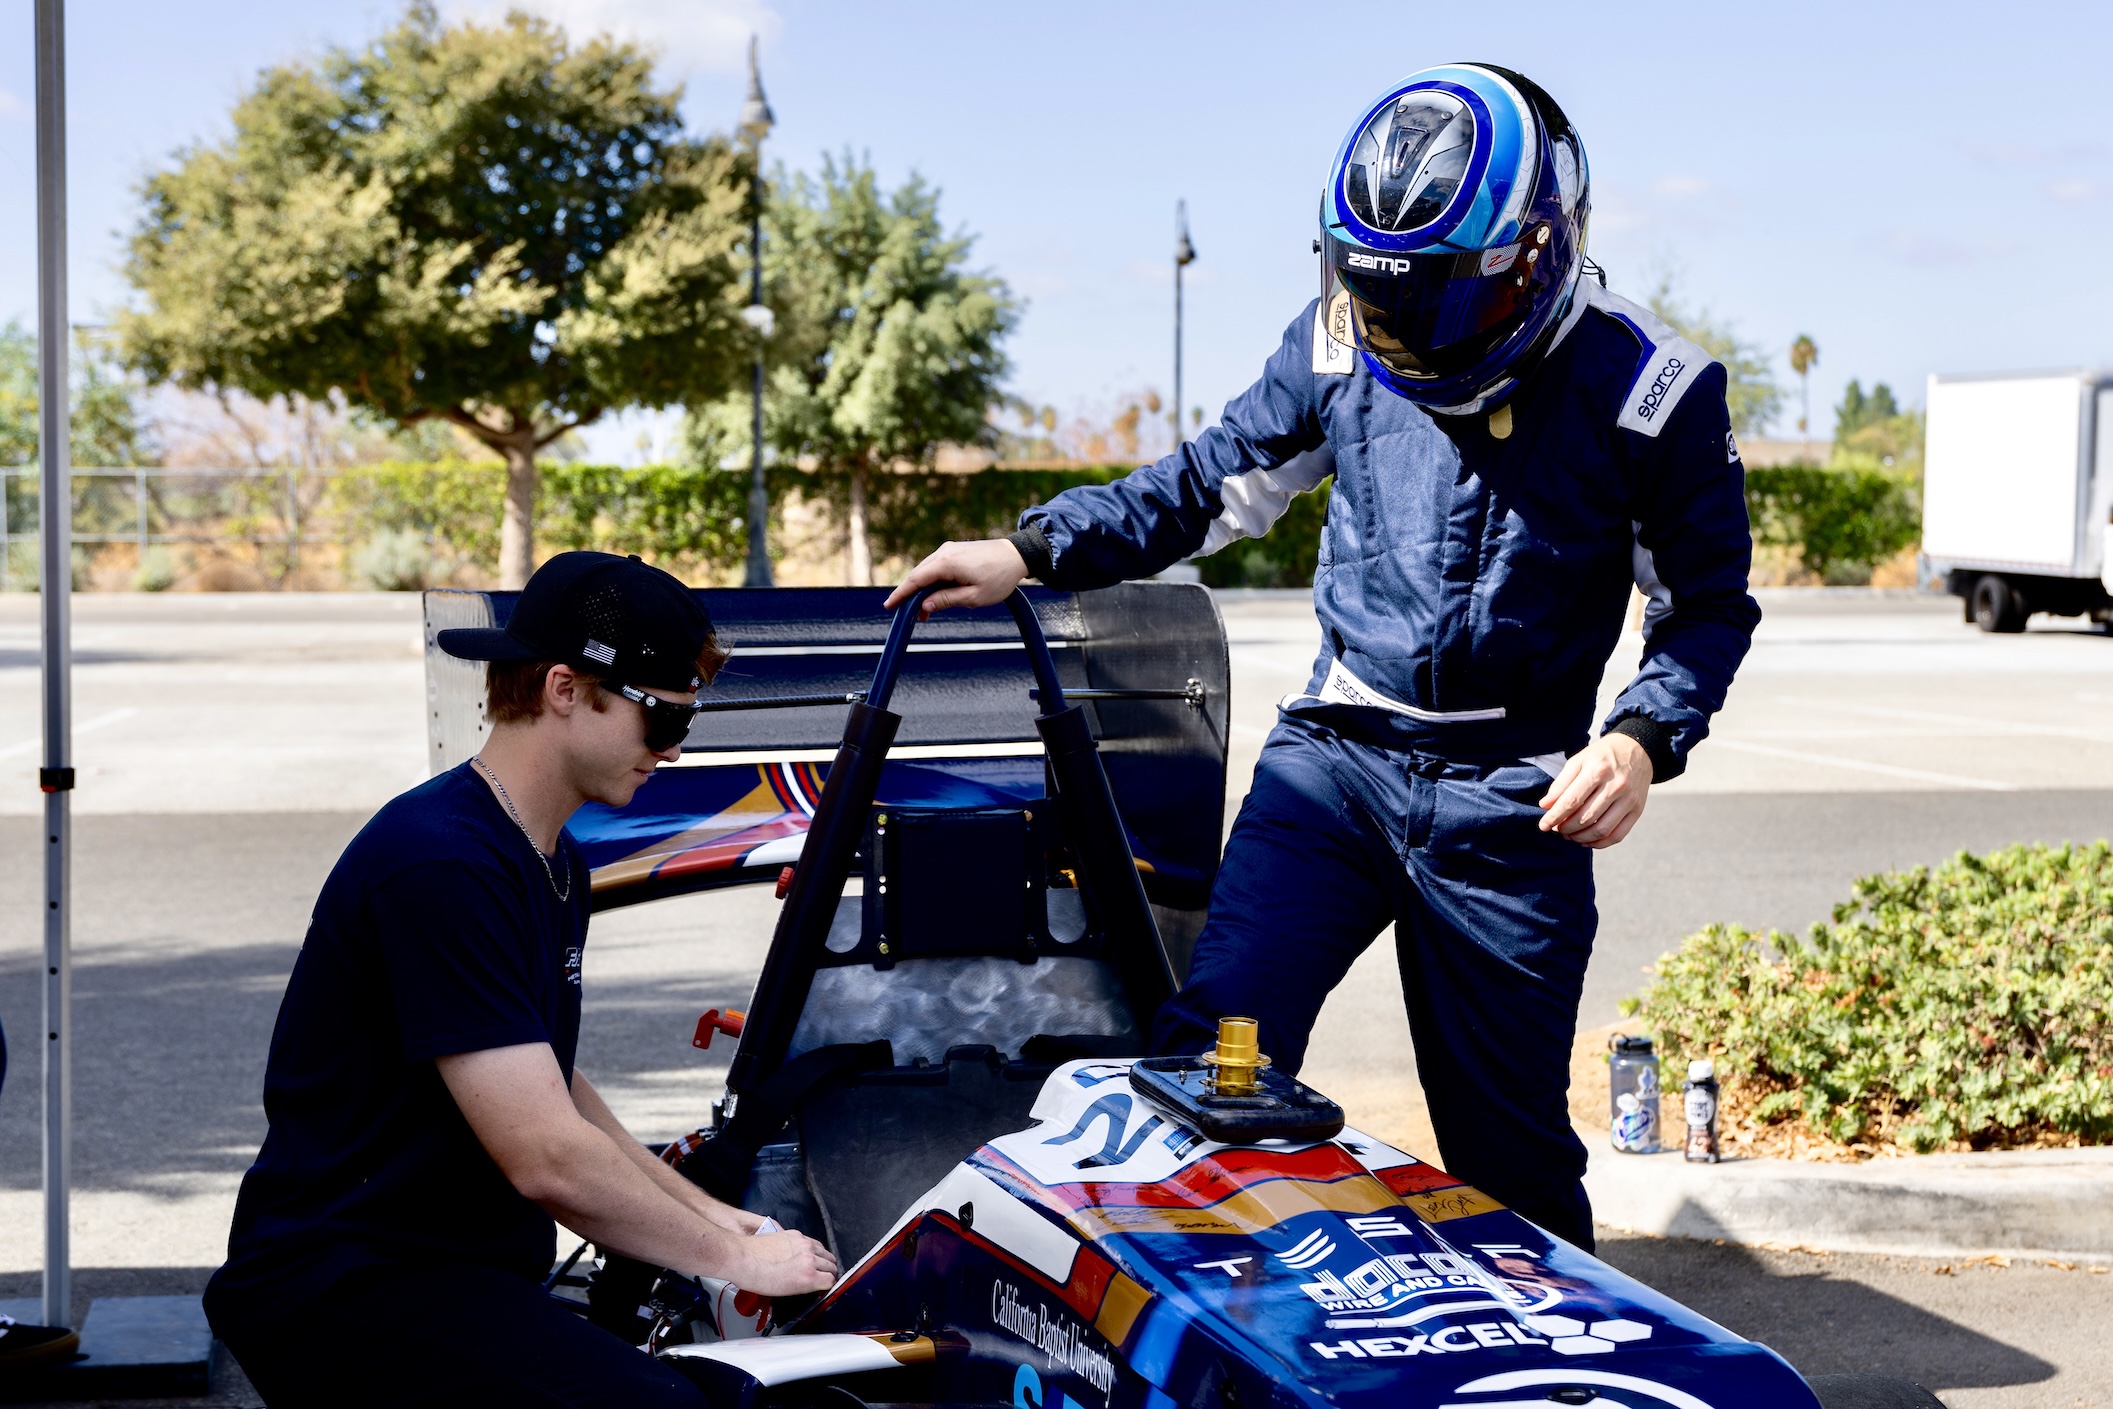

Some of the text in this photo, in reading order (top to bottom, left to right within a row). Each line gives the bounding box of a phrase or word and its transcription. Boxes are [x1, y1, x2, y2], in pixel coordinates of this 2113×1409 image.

[1348, 252, 1410, 276] zamp
[1638, 358, 1683, 420] sparco
[1319, 1293, 1389, 1311] WIRE
[1391, 1276, 1444, 1297] AND
[992, 1279, 1037, 1345] California
[1037, 1303, 1069, 1369] Baptist
[1070, 1321, 1115, 1408] University
[1309, 1322, 1549, 1359] HEXCEL
